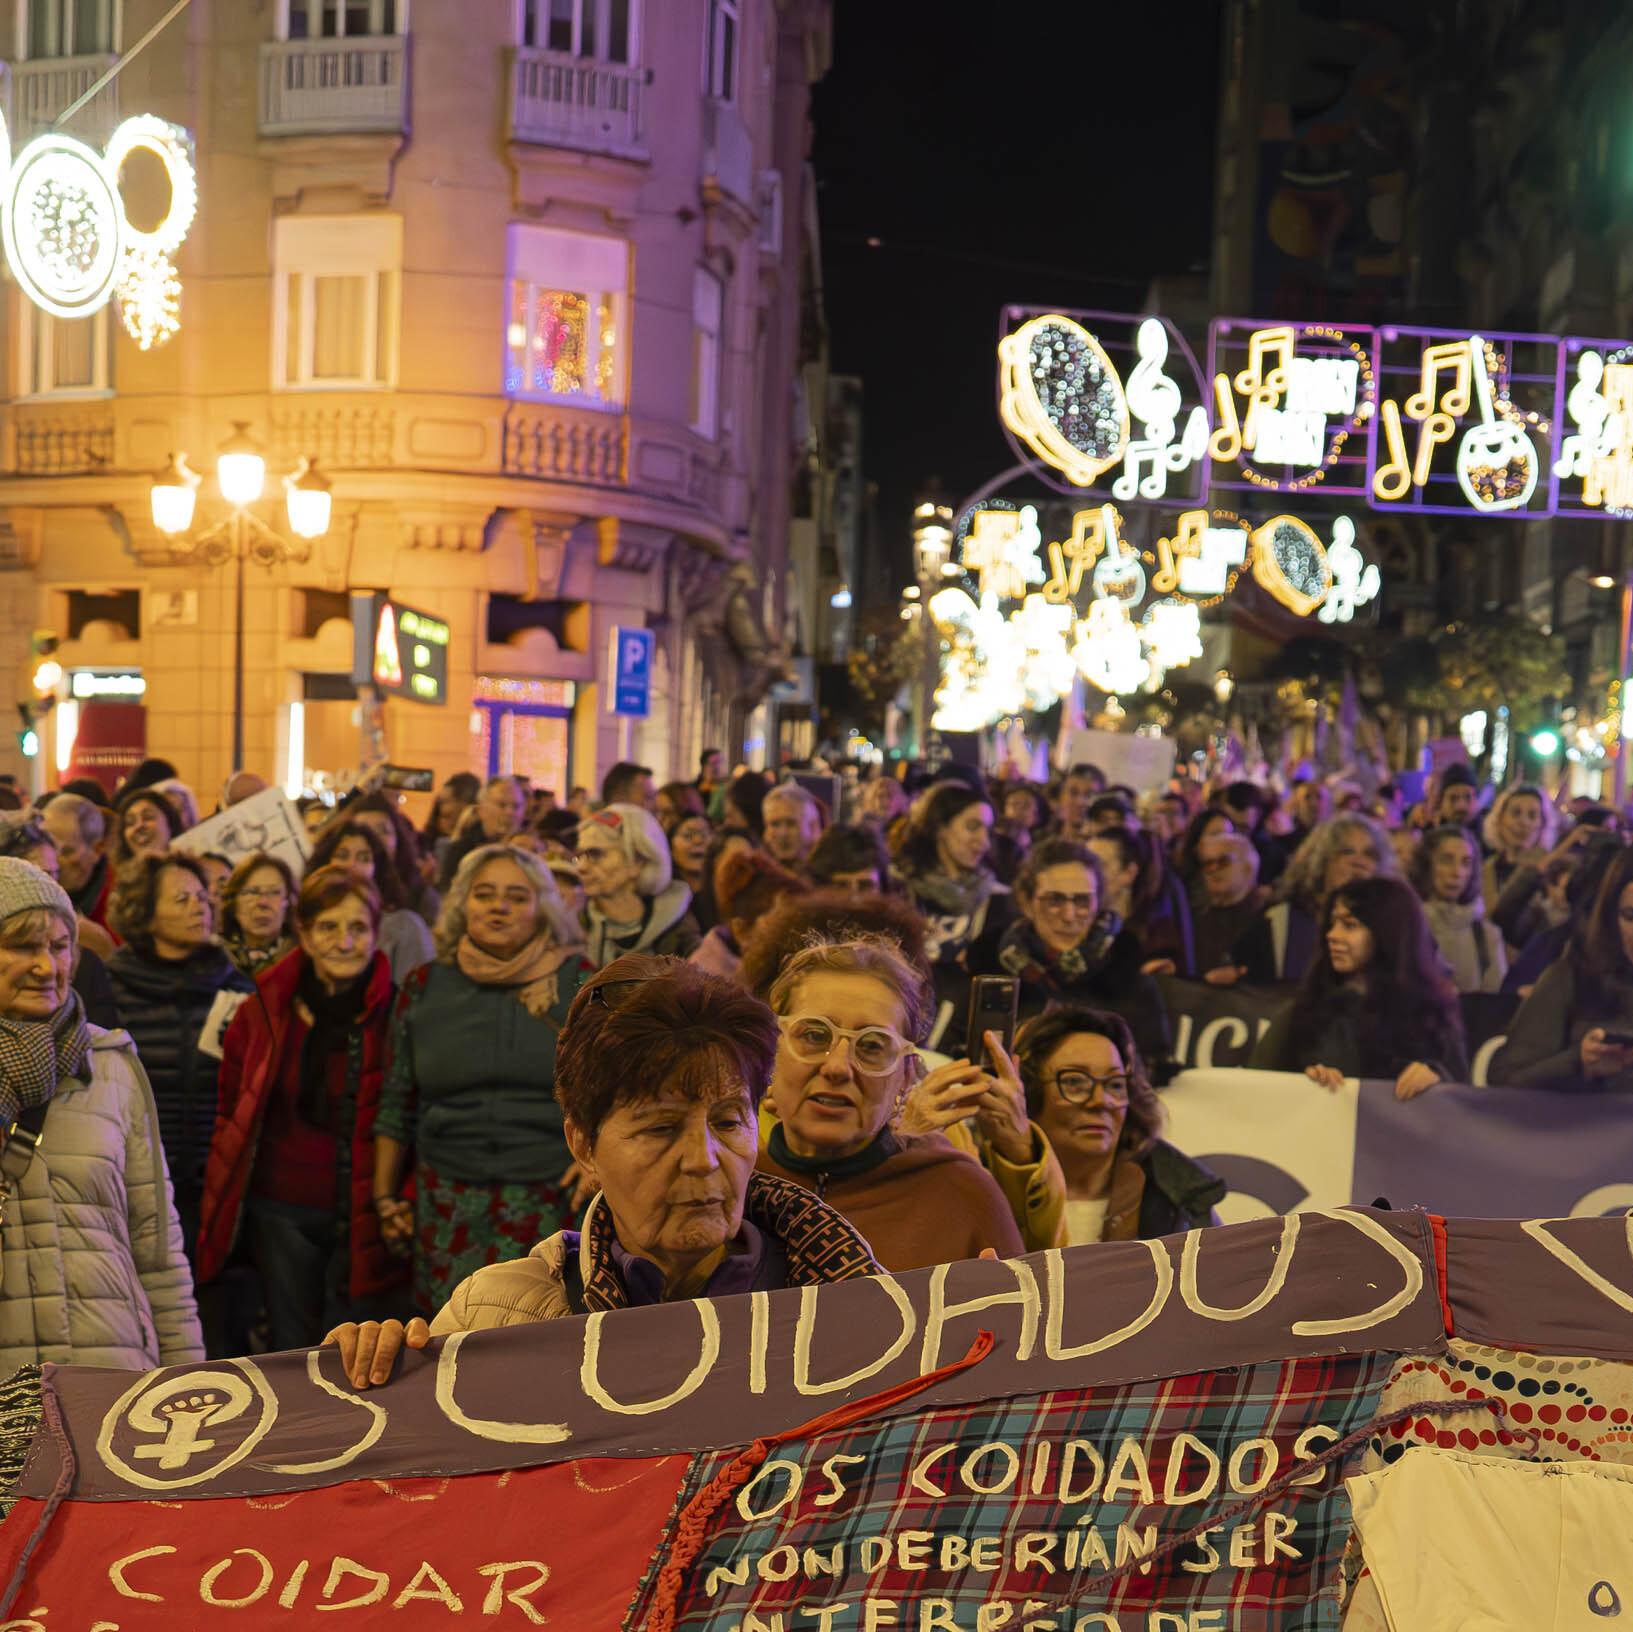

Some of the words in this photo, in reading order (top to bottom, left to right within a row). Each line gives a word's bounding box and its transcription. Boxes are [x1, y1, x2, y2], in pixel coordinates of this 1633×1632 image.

[736, 1453, 866, 1524] OS
[911, 1424, 1340, 1507] COIDADOS
[108, 1544, 554, 1626] COIDAR
[706, 1544, 844, 1597] NON
[1182, 1511, 1301, 1574] SER
[1587, 1581, 1621, 1618] O
